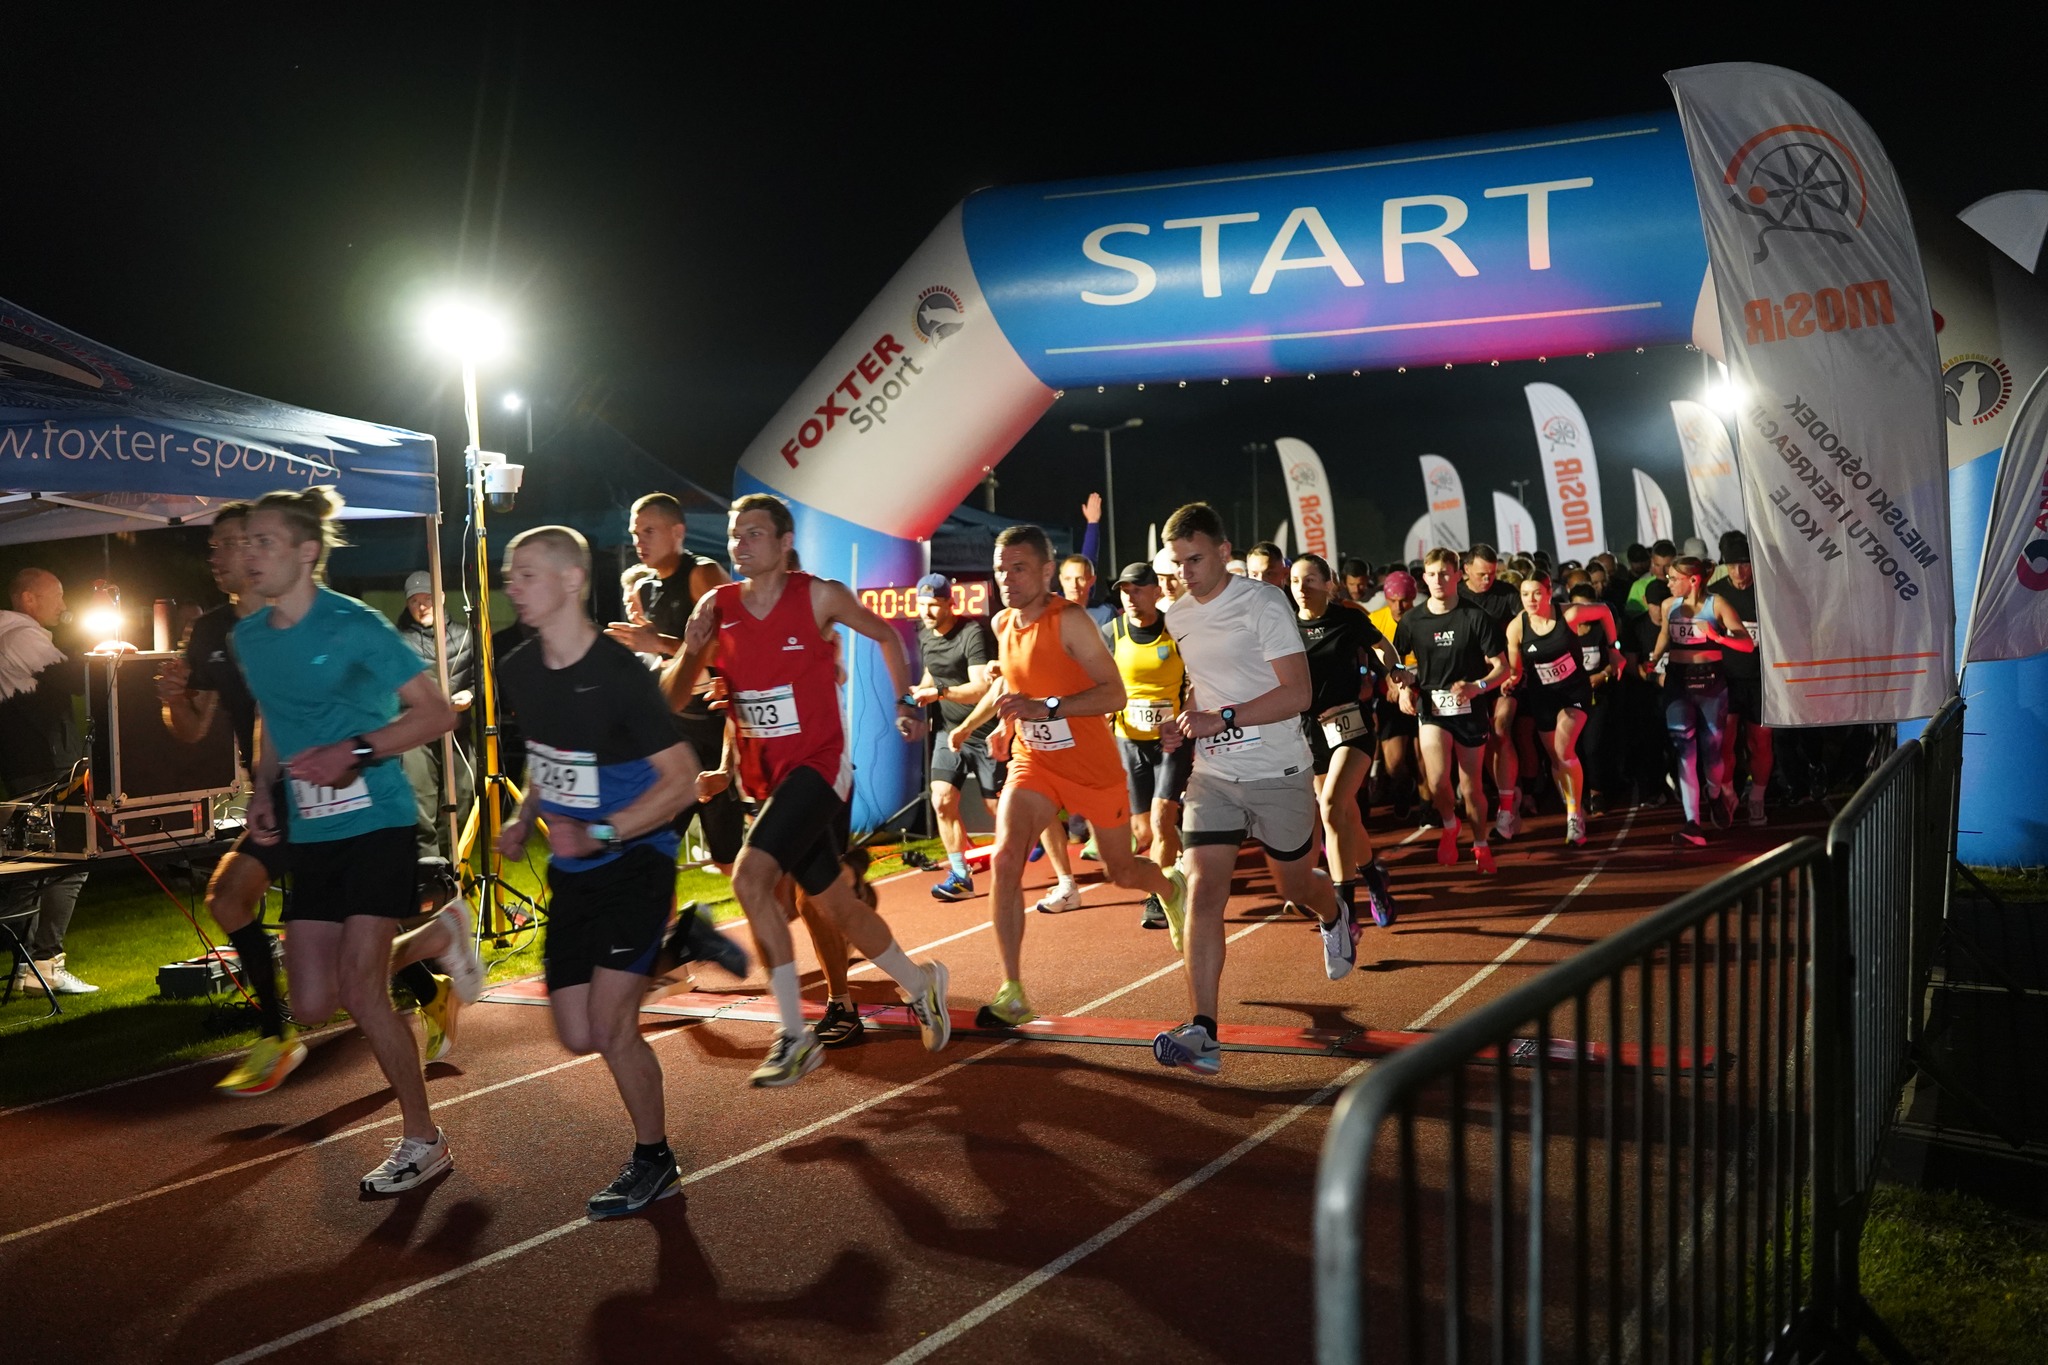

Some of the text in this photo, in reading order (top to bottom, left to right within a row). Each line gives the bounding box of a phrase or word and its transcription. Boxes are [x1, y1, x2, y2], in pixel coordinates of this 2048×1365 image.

[1081, 177, 1594, 306] START
[780, 333, 905, 469] FOXTER
[849, 355, 924, 434] Sport
[1433, 630, 1455, 641] KAT
[1679, 625, 1695, 638] 84
[1546, 664, 1567, 678] 180
[748, 704, 779, 726] 123
[1139, 709, 1163, 723] 186
[1032, 724, 1052, 741] 43
[1334, 715, 1351, 733] 60
